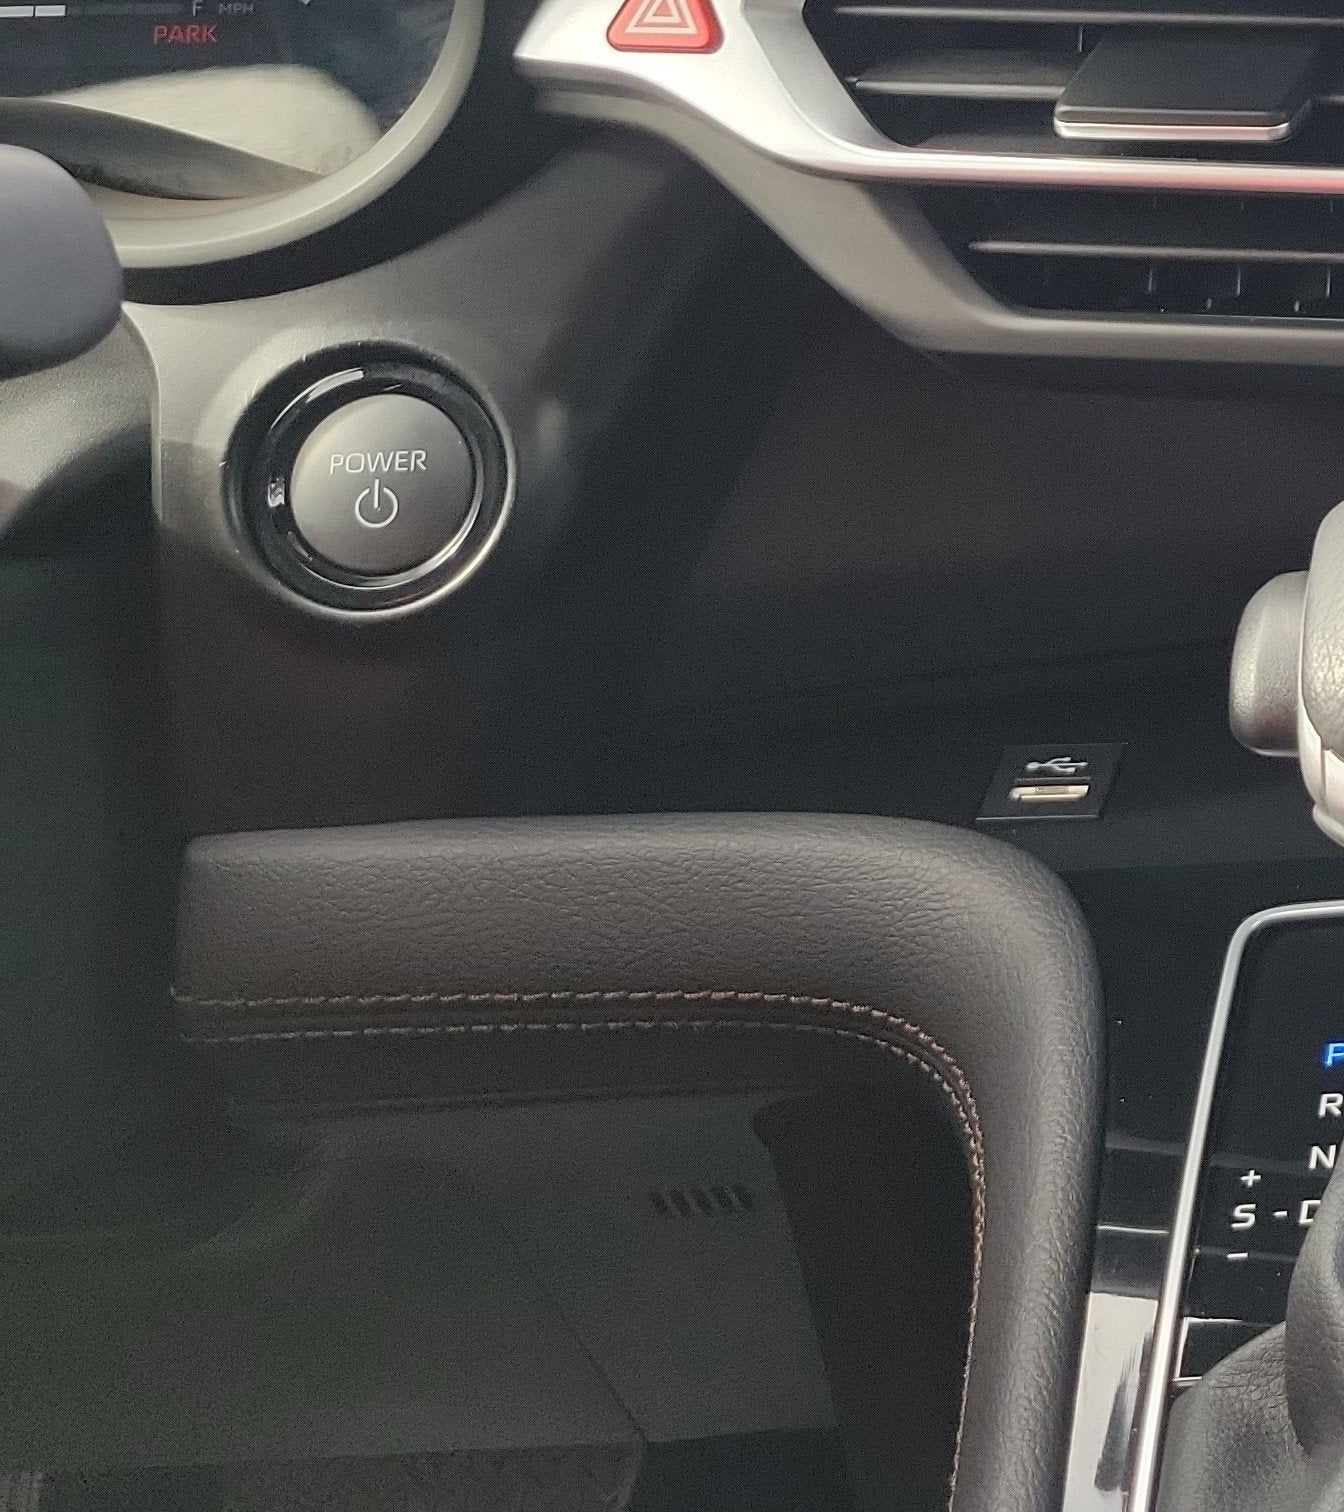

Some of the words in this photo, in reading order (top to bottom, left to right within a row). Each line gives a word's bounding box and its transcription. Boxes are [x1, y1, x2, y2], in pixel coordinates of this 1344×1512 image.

[192, 0, 203, 16] F
[218, 2, 254, 15] MPH
[153, 25, 218, 44] PARK
[329, 450, 427, 475] POWER
[1318, 1093, 1344, 1118] R
[1309, 1144, 1337, 1170] N
[1231, 1203, 1257, 1230] S
